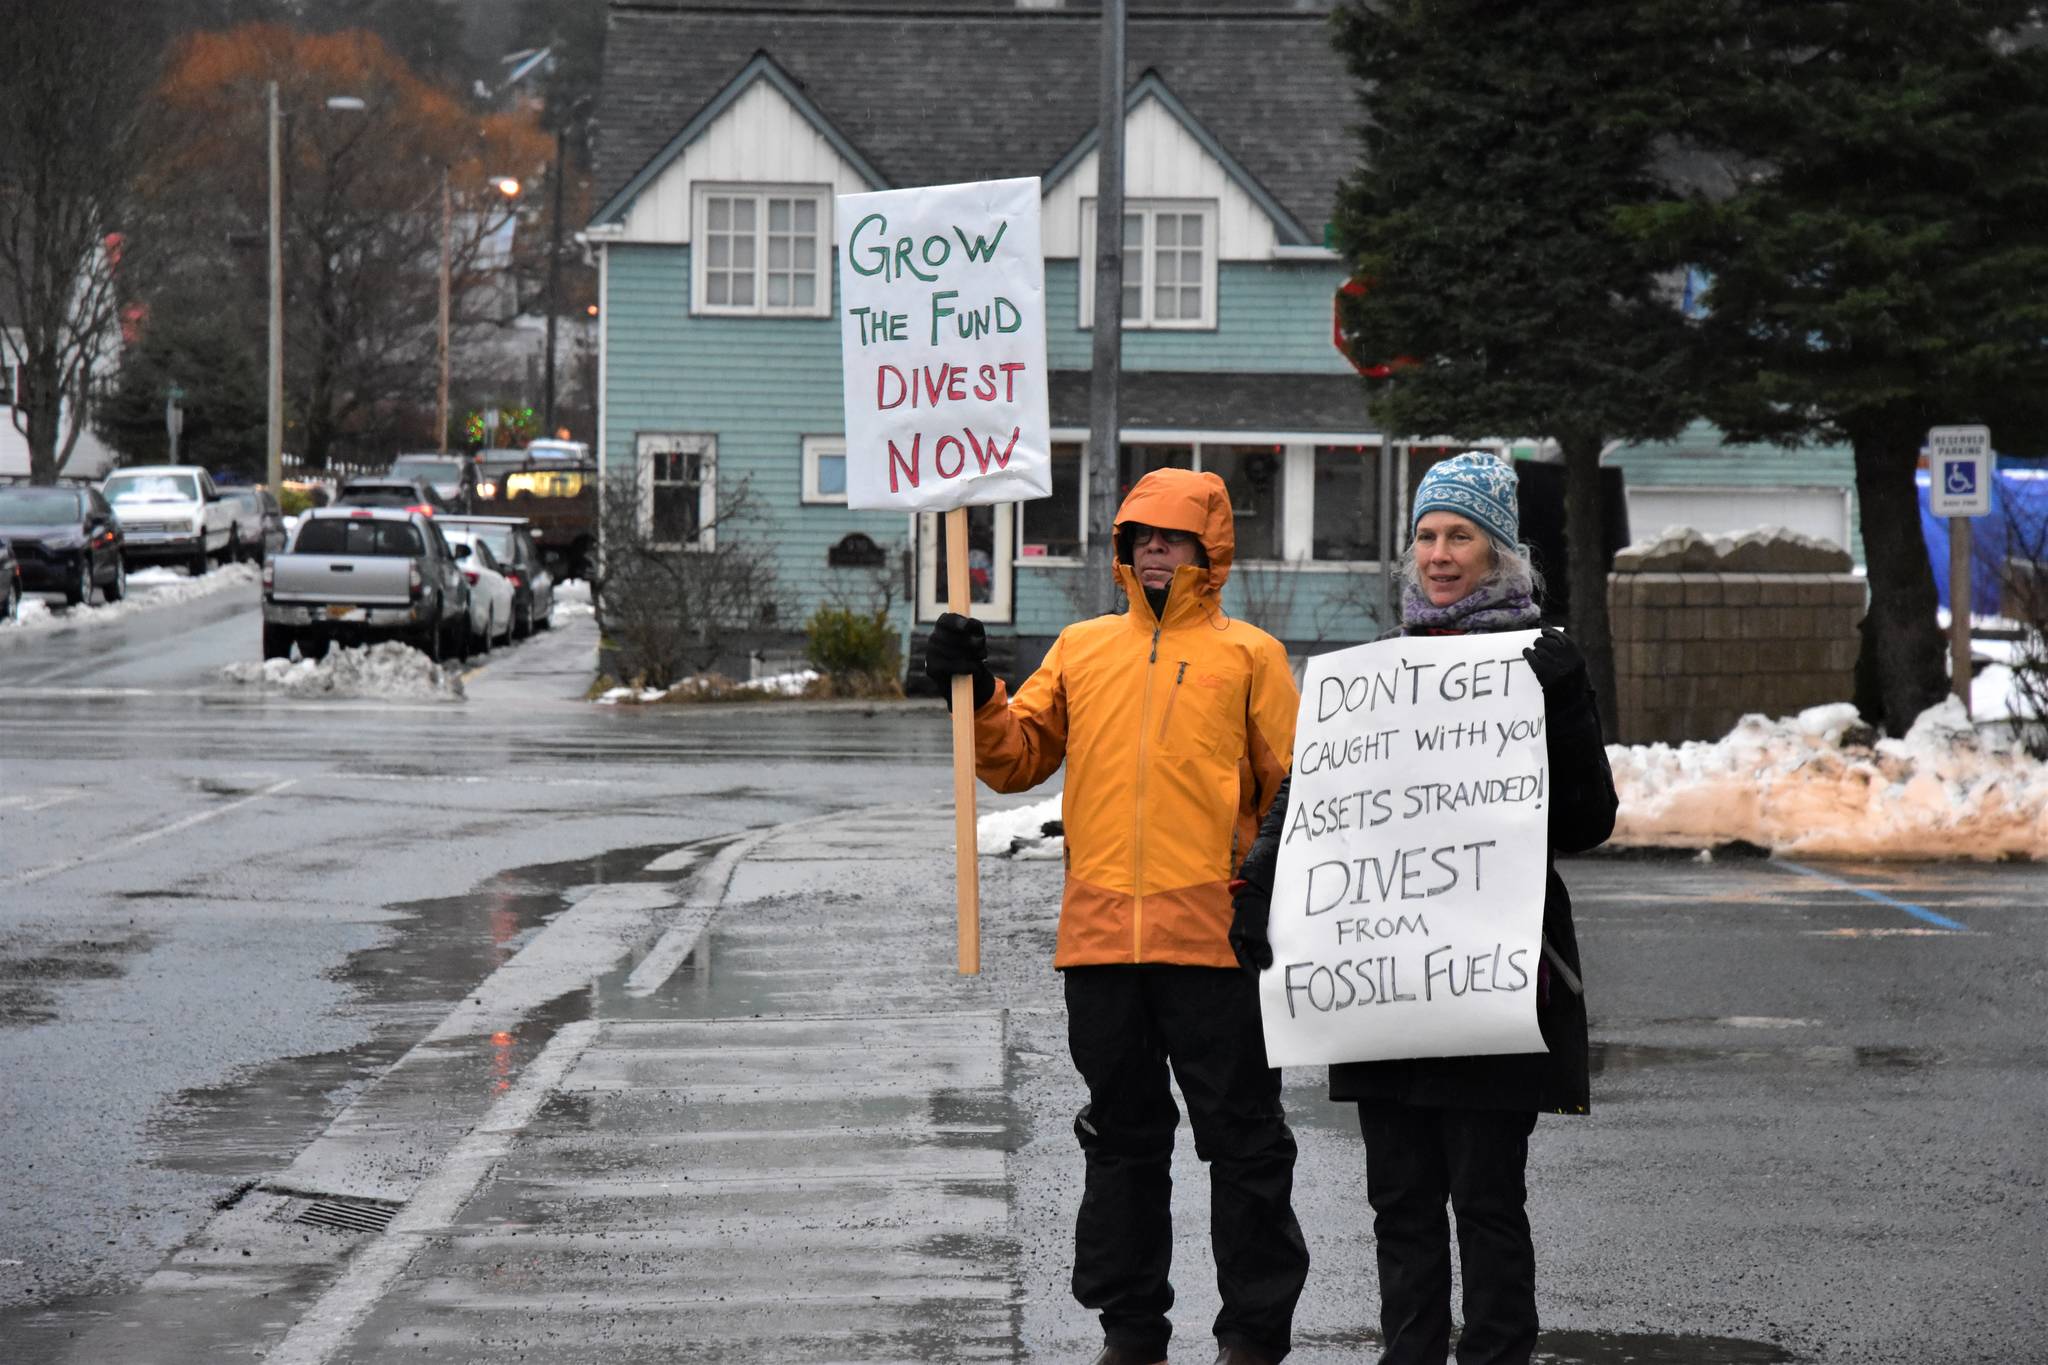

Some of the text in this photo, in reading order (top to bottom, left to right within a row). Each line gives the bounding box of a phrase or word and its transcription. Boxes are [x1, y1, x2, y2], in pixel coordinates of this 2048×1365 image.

[849, 213, 1007, 283] GROW
[849, 290, 1022, 346] THE FUND
[877, 362, 1025, 411] DIVEST
[888, 427, 1020, 493] NOW
[1934, 435, 1985, 446] RESERVED
[1938, 446, 1982, 456] PARKING
[1318, 658, 1526, 722] DON'T GET
[1300, 729, 1399, 775] CAUGHT
[1286, 767, 1544, 845] ASSETS STRANDED!
[1305, 841, 1496, 917] DIVEST
[1337, 914, 1429, 945] FROM
[1285, 943, 1528, 1019] FOSSIL FUELS
